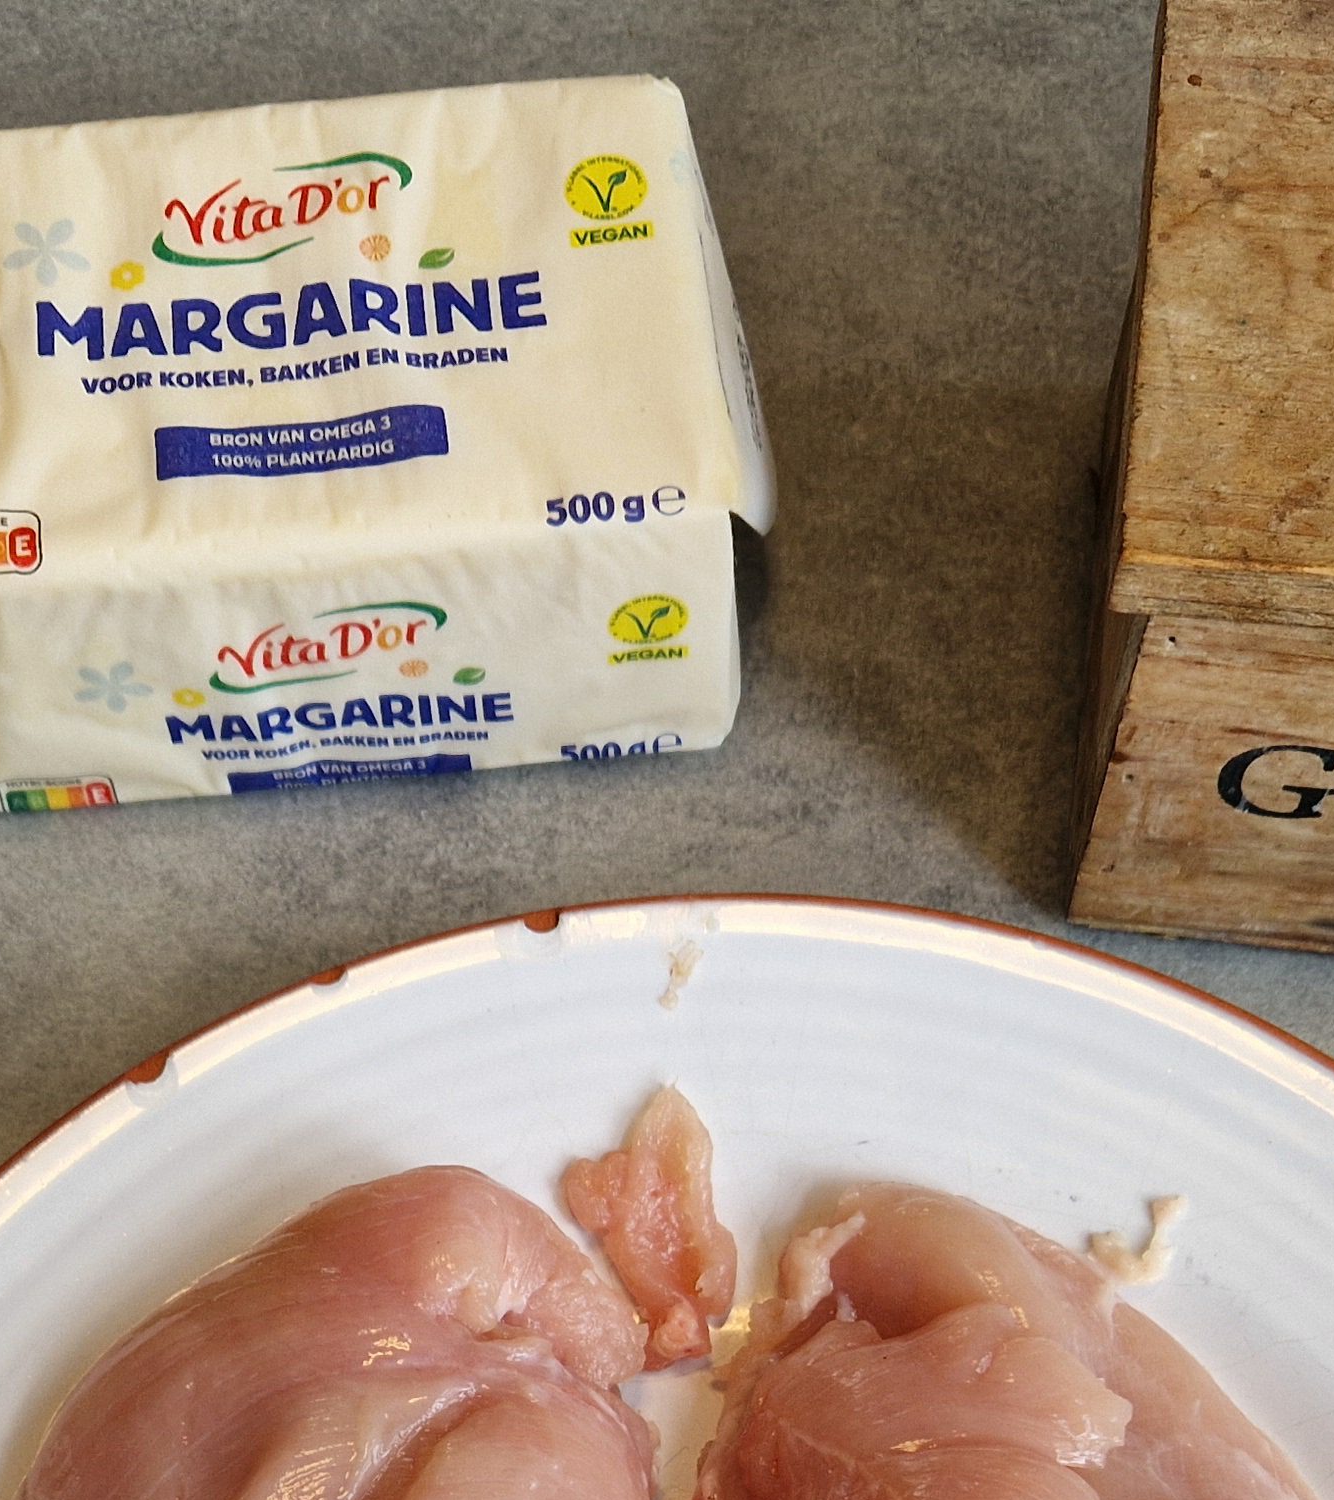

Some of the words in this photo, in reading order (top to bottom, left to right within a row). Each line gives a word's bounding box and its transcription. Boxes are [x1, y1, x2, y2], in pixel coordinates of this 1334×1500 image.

[164, 178, 285, 247] Vita
[288, 175, 390, 226] D'or
[573, 223, 648, 246] VEGAN
[34, 270, 549, 364] MARGARINE
[80, 371, 153, 395] VOOR
[160, 368, 255, 389] KOKEN,
[260, 351, 362, 383] BAKKEN
[367, 347, 399, 366] EN
[405, 347, 509, 370] BRADEN
[208, 430, 264, 448] BRON
[268, 428, 305, 446] VAN
[309, 418, 377, 443] OMEGA
[380, 415, 392, 431] 3
[211, 453, 263, 470] 100%
[266, 438, 396, 468] PLANTAARDIG
[546, 491, 615, 527] 500
[15, 534, 32, 558] E
[217, 622, 330, 678] Vita
[329, 617, 427, 660] D'or
[612, 647, 683, 664] VEGAN
[165, 691, 515, 745] MARGARINE
[203, 748, 258, 761] VOOR
[255, 739, 317, 760] KOKEN,
[320, 736, 389, 748] BAKKEN
[393, 735, 415, 746] EN
[419, 730, 489, 743] BRADEN
[272, 764, 317, 781] BRON
[319, 762, 353, 775] VAN
[356, 760, 413, 772] OMEGA
